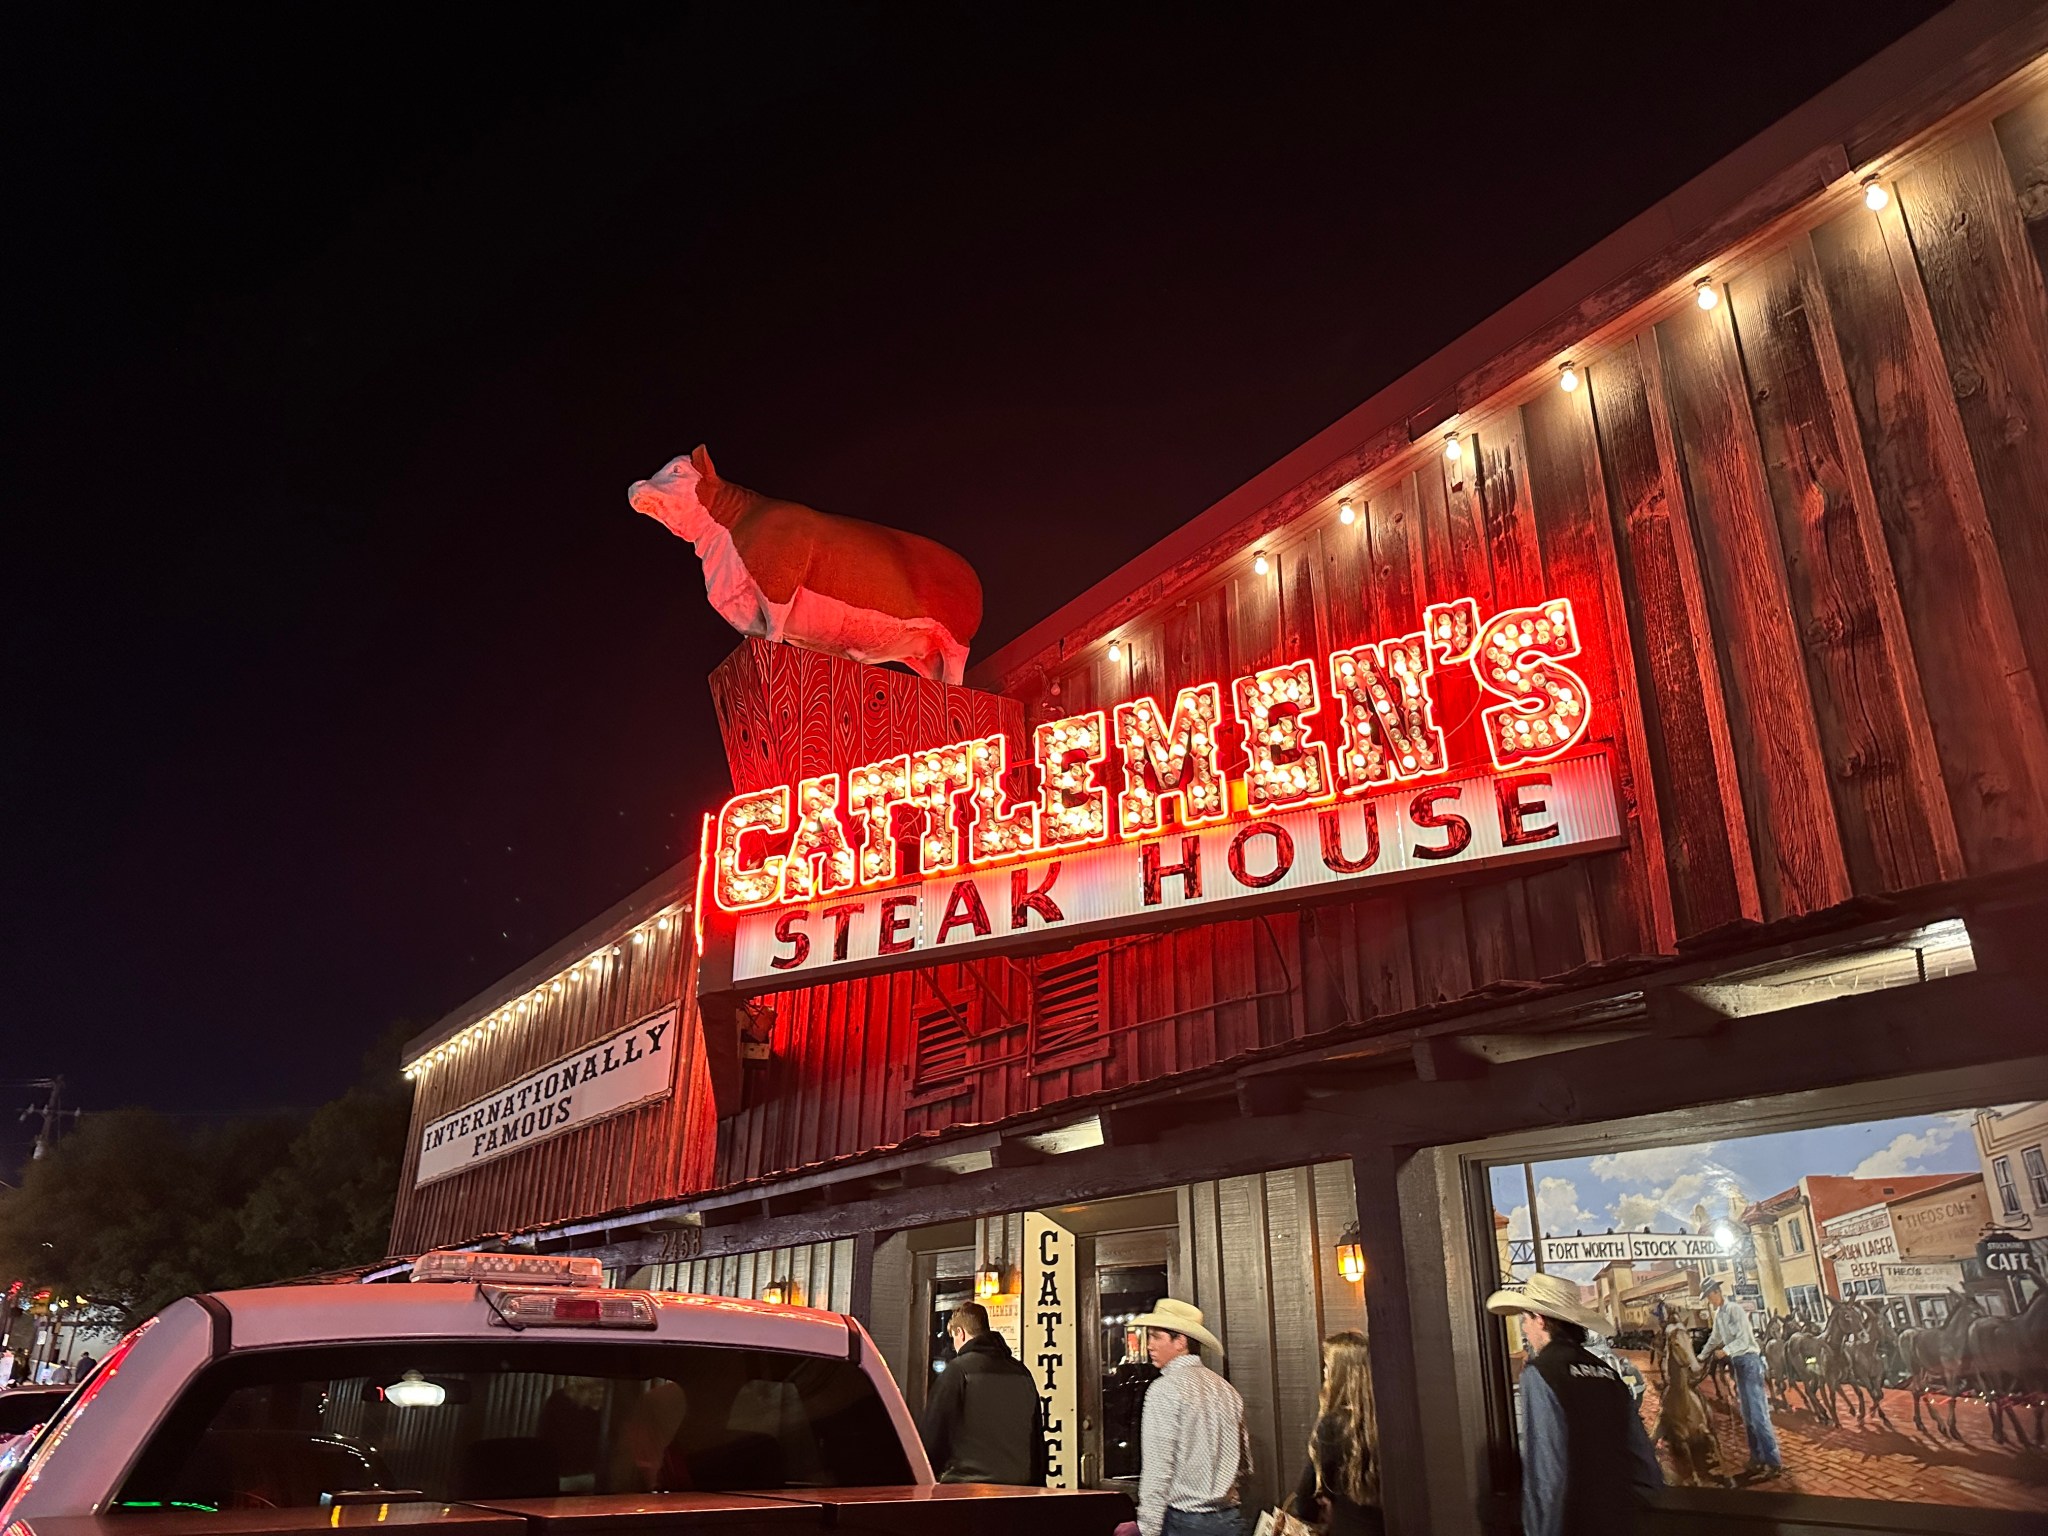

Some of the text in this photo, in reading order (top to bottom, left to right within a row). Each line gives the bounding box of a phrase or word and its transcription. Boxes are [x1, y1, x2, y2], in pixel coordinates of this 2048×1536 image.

[714, 596, 1593, 911] CATTLEMEN'S
[770, 771, 1561, 971] STEAK HOUSE
[424, 1020, 670, 1152] INTERNATIONALLY
[472, 1096, 572, 1158] FAMOUS
[659, 1227, 700, 1262] 2458
[1547, 1242, 1579, 1259] FORT
[1583, 1242, 1625, 1258] WORTH
[1633, 1240, 1677, 1256] STOCK
[1850, 1261, 1880, 1277] BEER
[1861, 1236, 1896, 1259] LAGER
[1037, 1231, 1065, 1488] CATTLE
